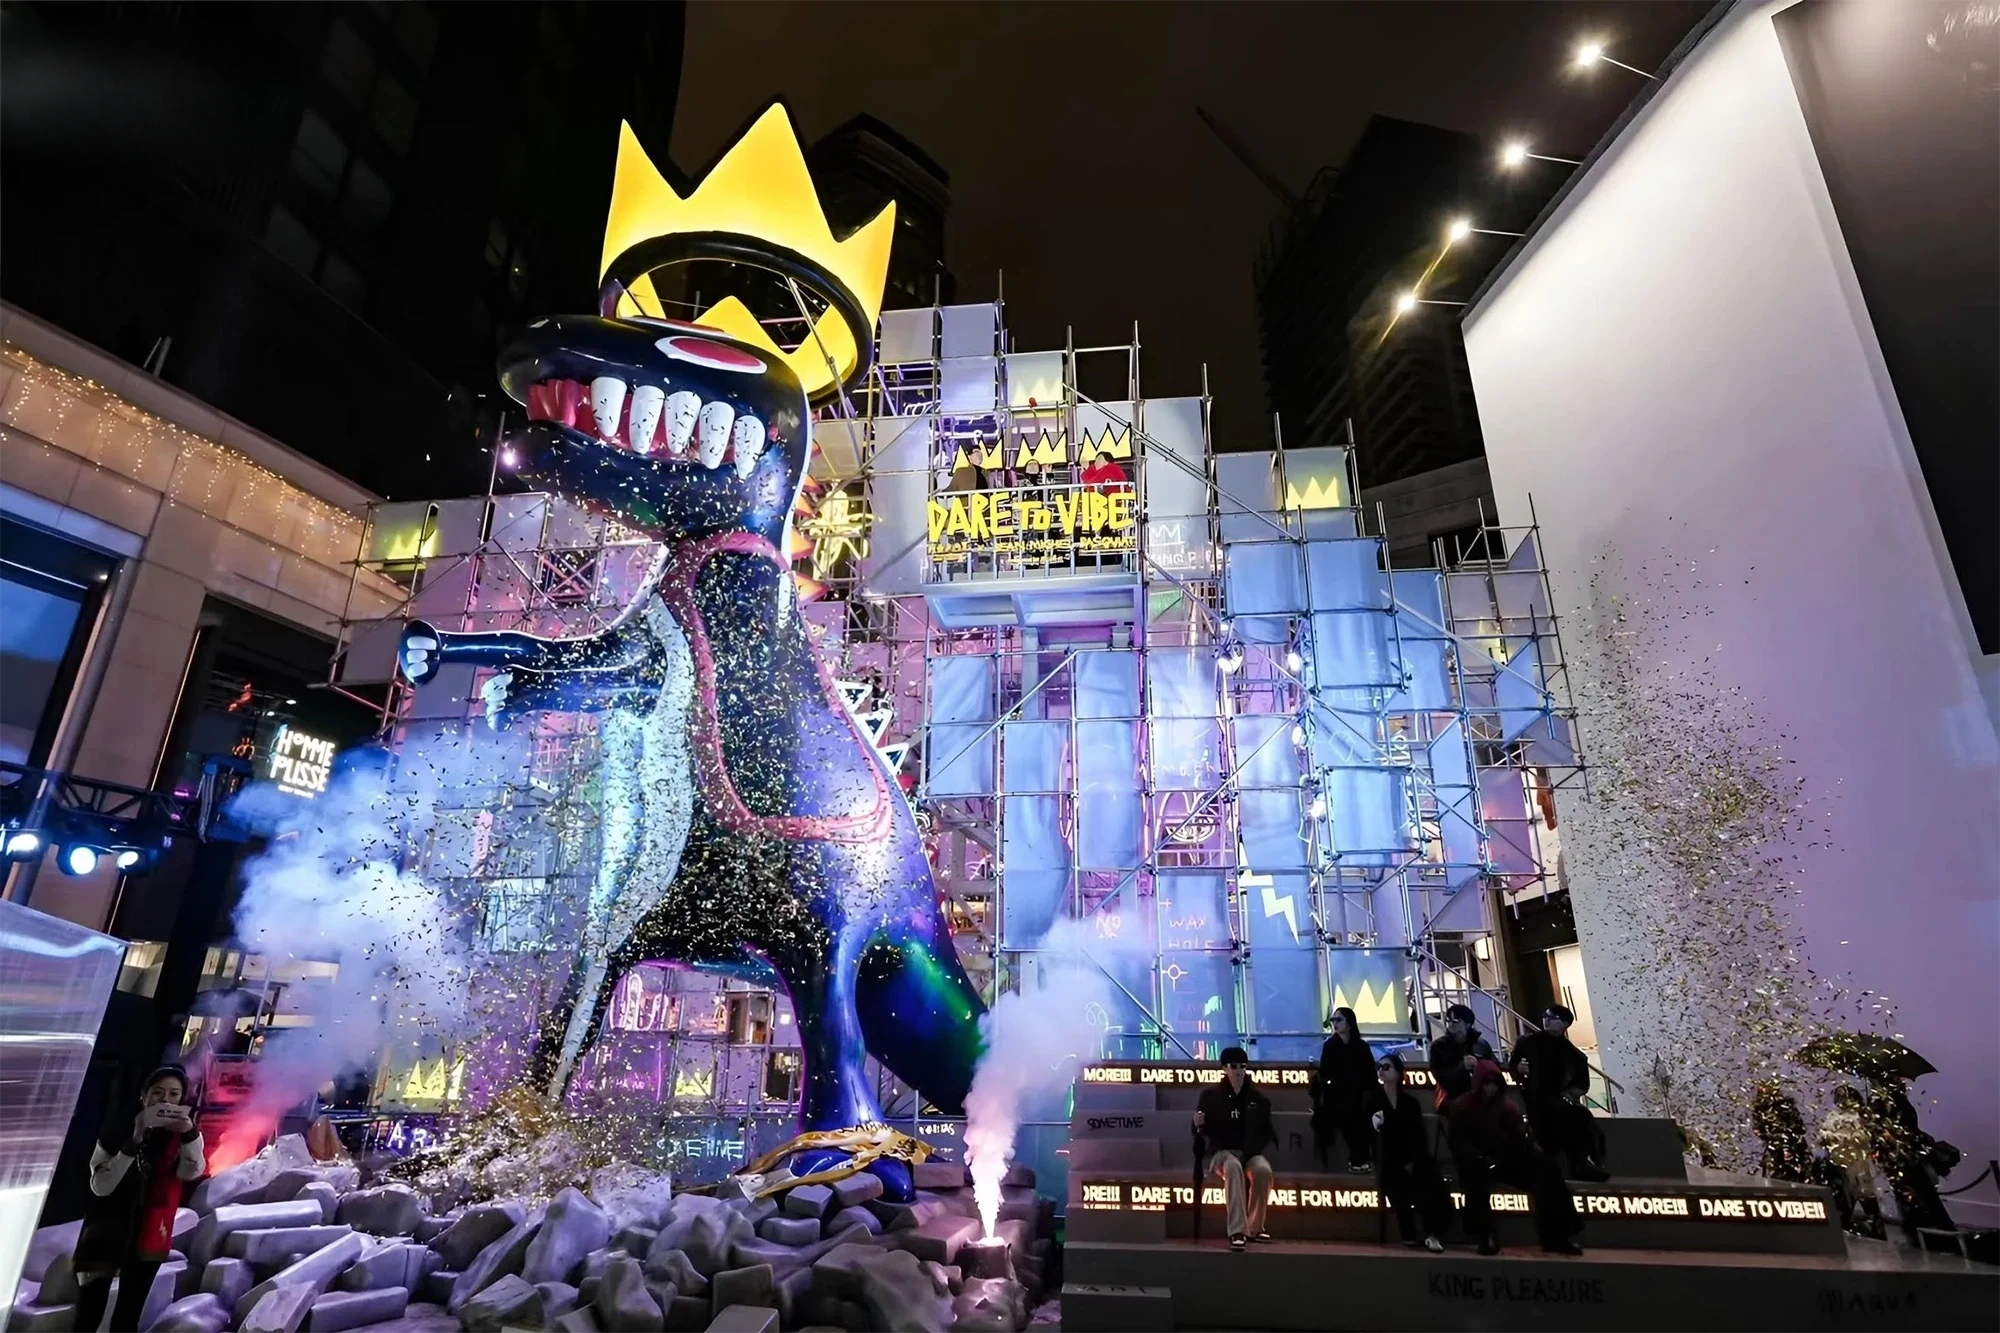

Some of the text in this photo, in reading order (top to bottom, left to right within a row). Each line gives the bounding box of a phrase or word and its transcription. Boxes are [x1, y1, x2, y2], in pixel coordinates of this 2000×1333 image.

[926, 493, 1014, 543] DARE
[1055, 492, 1137, 535] VIBE
[1141, 1068, 1174, 1082] DARE
[1176, 1069, 1195, 1083] TO
[1282, 1070, 1309, 1083] FOR
[1407, 1070, 1426, 1085] TO
[1131, 1186, 1171, 1203] DARE
[1173, 1187, 1194, 1204] TO
[1267, 1189, 1298, 1206] ARE
[1300, 1190, 1333, 1206] FOR
[1586, 1197, 1621, 1214] FOR
[1699, 1198, 1746, 1217] DARE
[1745, 1200, 1773, 1218] TO
[1429, 1271, 1606, 1303] KING PLEASURE
